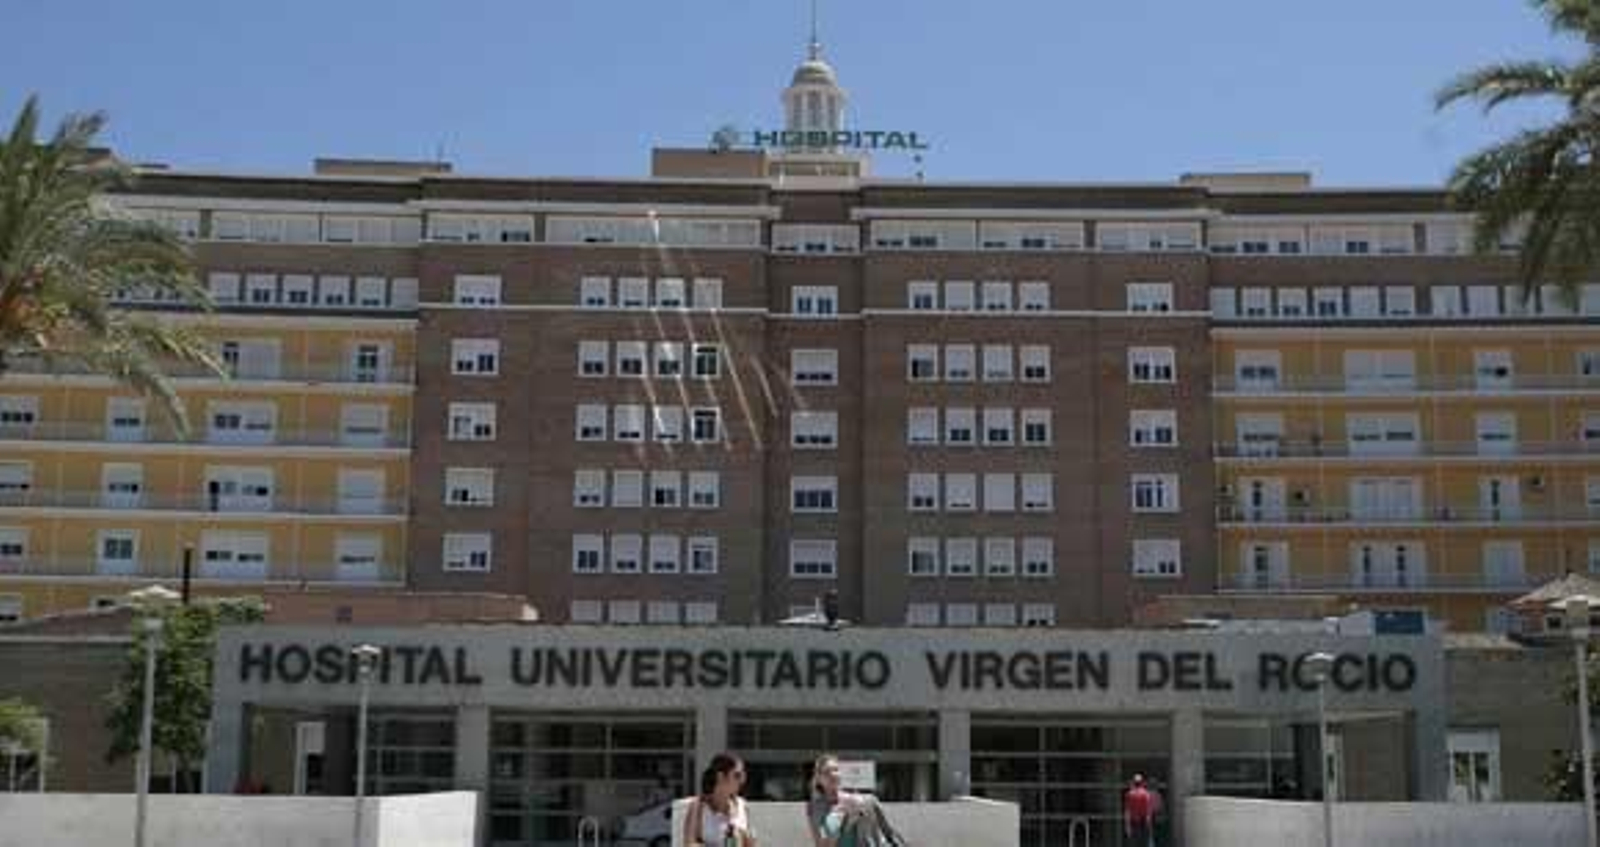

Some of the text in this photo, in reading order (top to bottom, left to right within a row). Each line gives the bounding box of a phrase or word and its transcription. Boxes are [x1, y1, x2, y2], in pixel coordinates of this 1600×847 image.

[754, 130, 928, 149] HOSPITAL
[239, 643, 484, 685] HOSPITAL
[510, 648, 892, 689] UNIVERSITARIO
[925, 651, 1110, 691] VIRGEN
[1137, 652, 1234, 691] DEL
